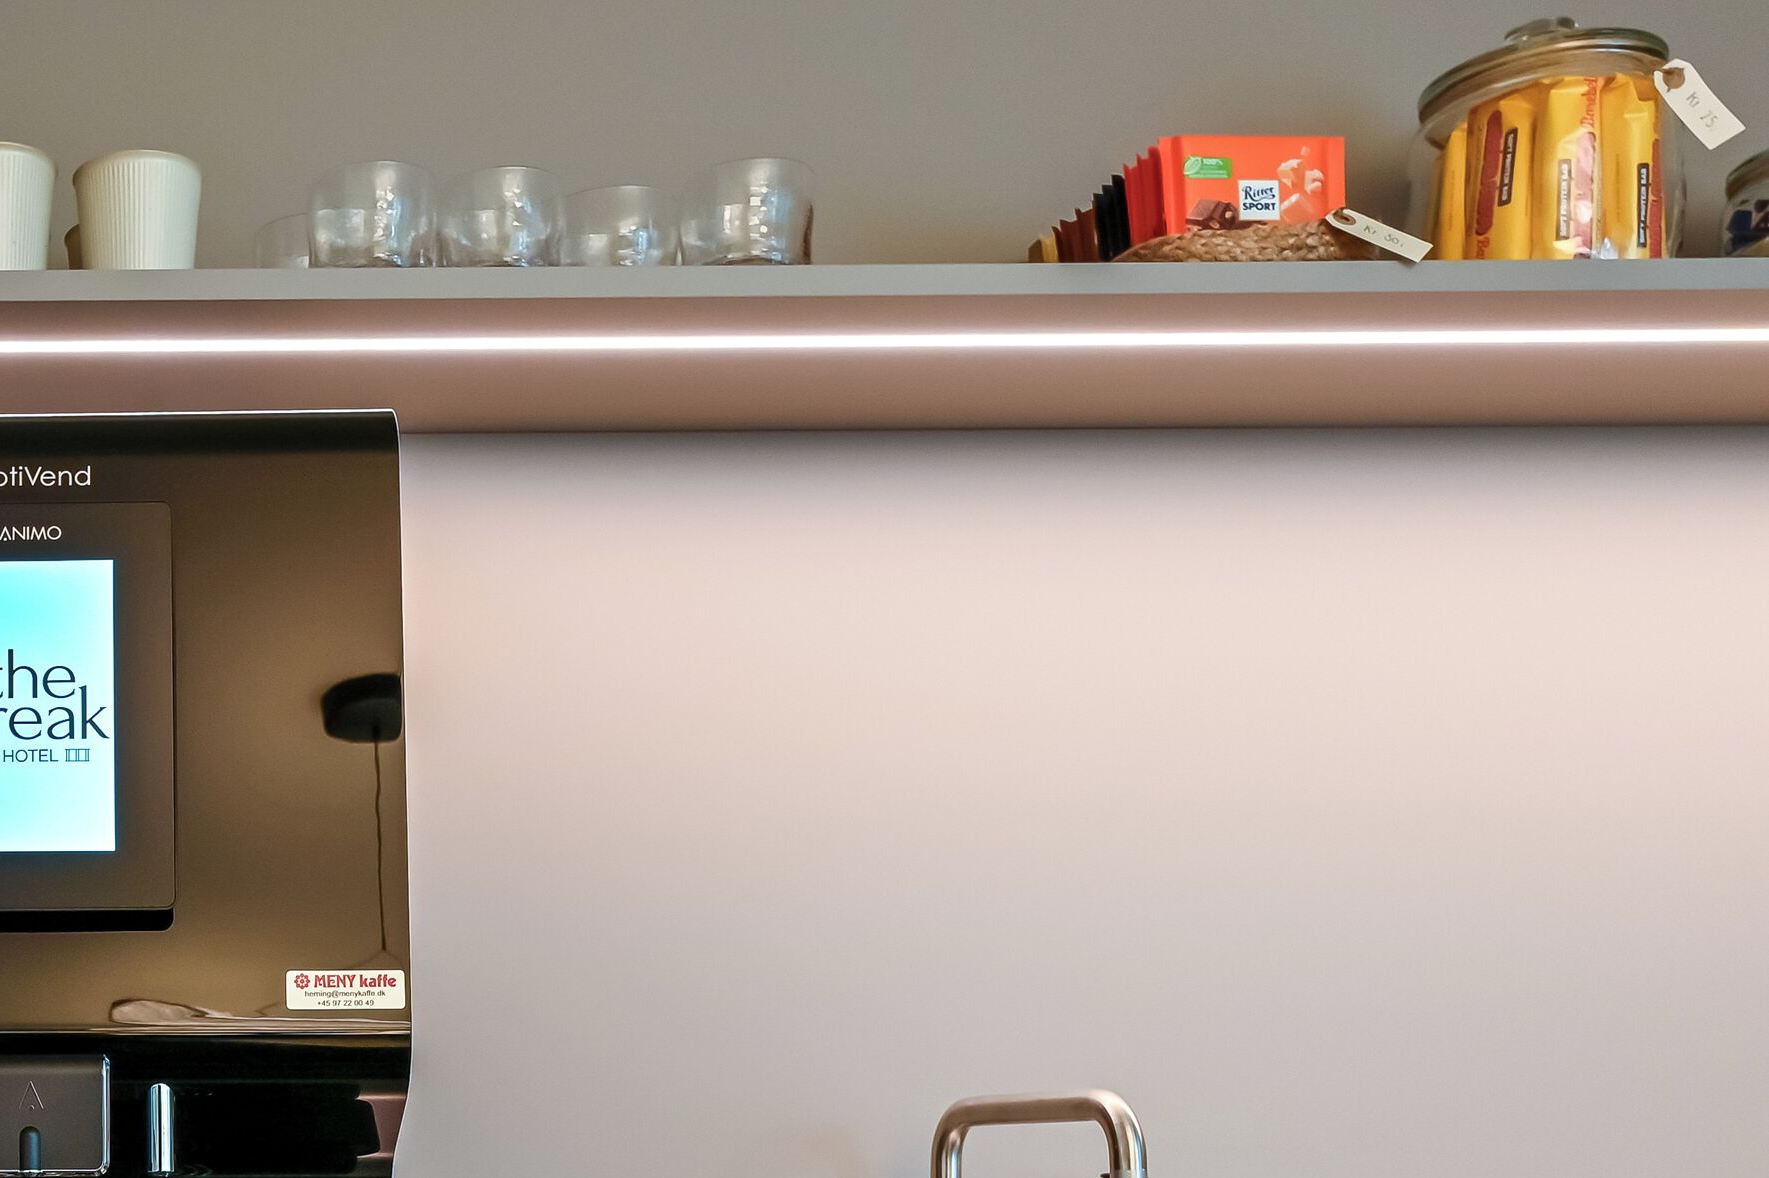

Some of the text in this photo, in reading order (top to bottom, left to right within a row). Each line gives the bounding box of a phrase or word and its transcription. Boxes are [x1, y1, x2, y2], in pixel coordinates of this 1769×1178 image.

[1242, 185, 1276, 201] Ritter
[1242, 202, 1276, 211] SPORT
[2, 748, 59, 763] HOTEL
[314, 974, 397, 988] MENY kaffe
